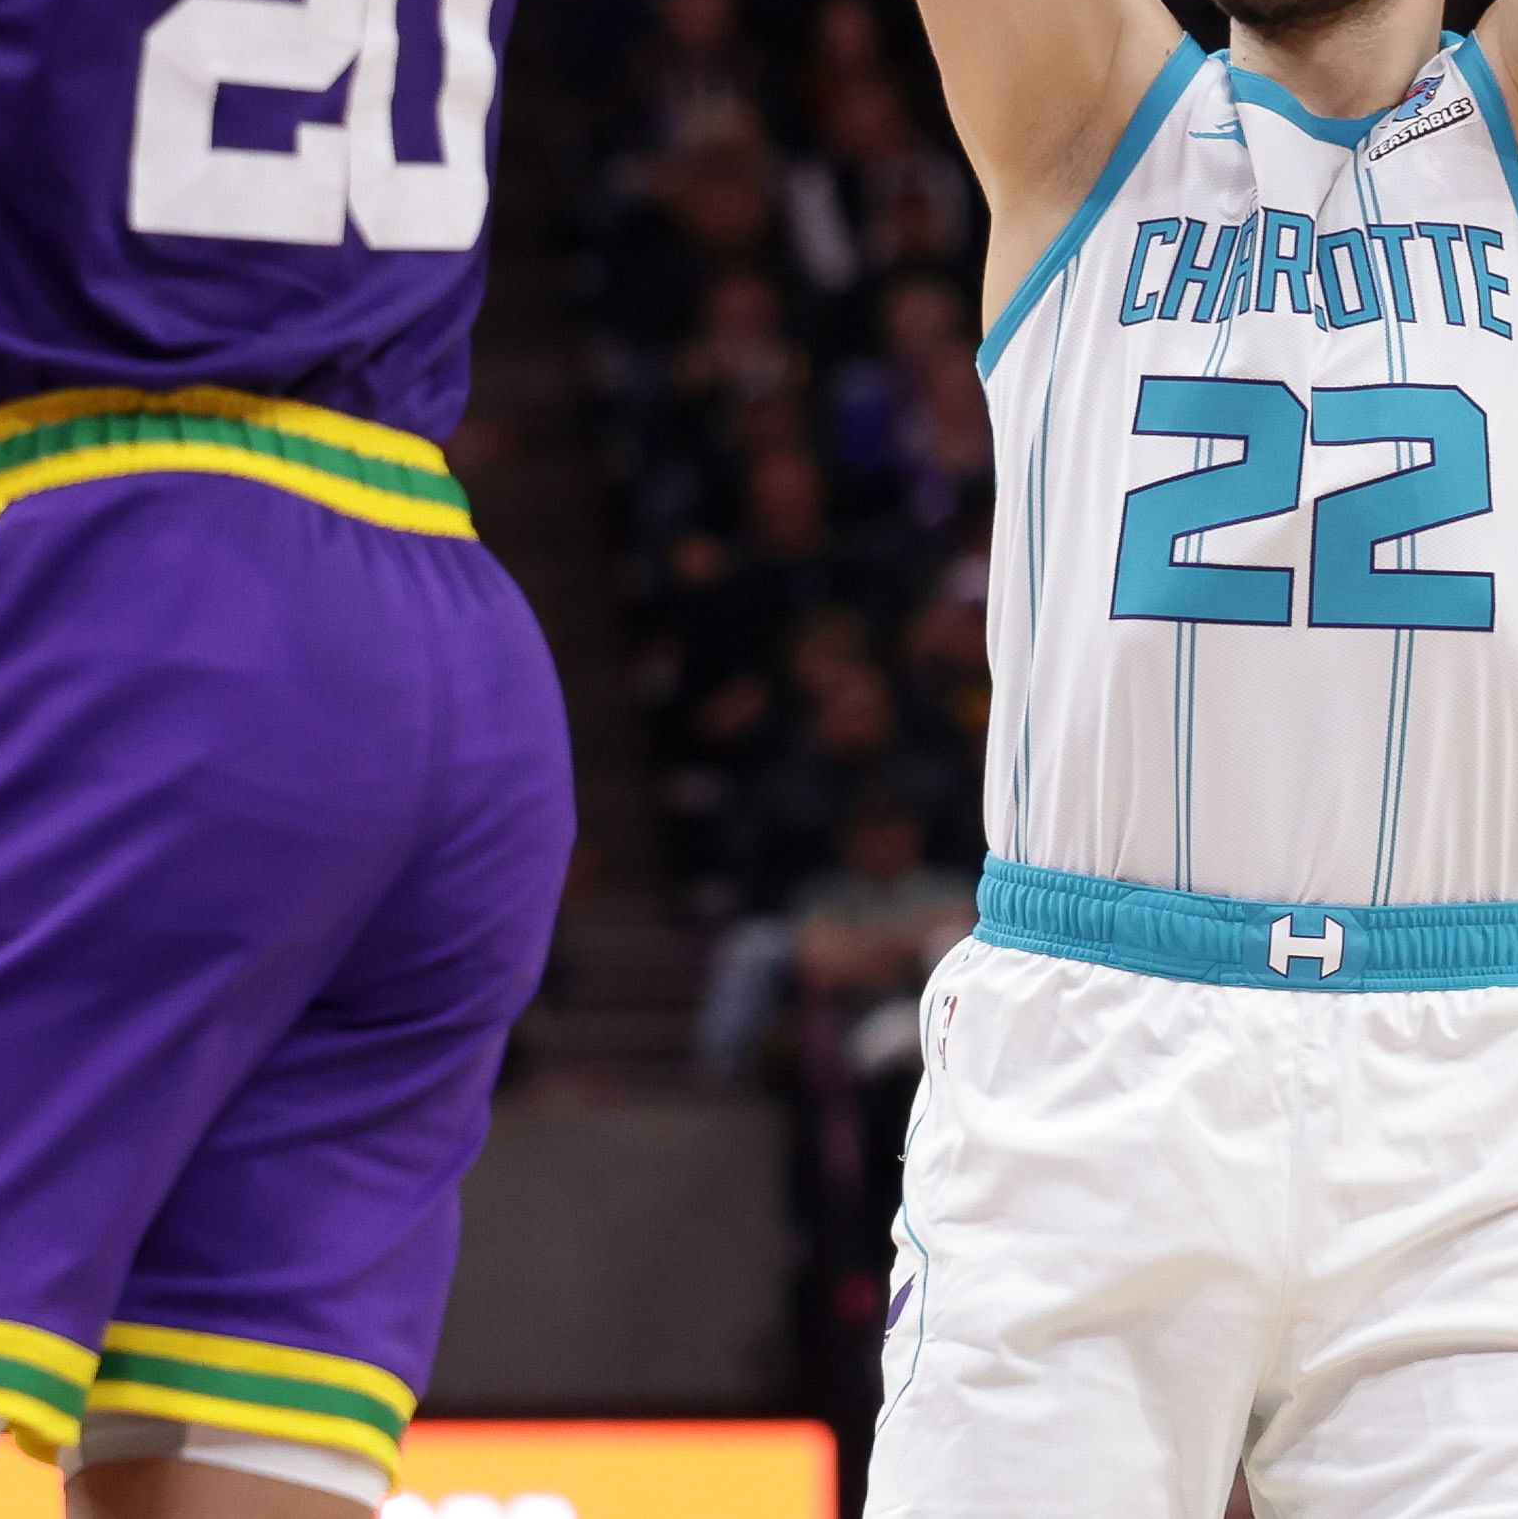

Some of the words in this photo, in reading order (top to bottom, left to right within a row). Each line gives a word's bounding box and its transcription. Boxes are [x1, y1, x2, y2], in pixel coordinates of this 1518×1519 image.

[1369, 97, 1474, 161] FEASTABLES
[1119, 205, 1513, 340] CHAROTTE
[1109, 374, 1496, 633] 22
